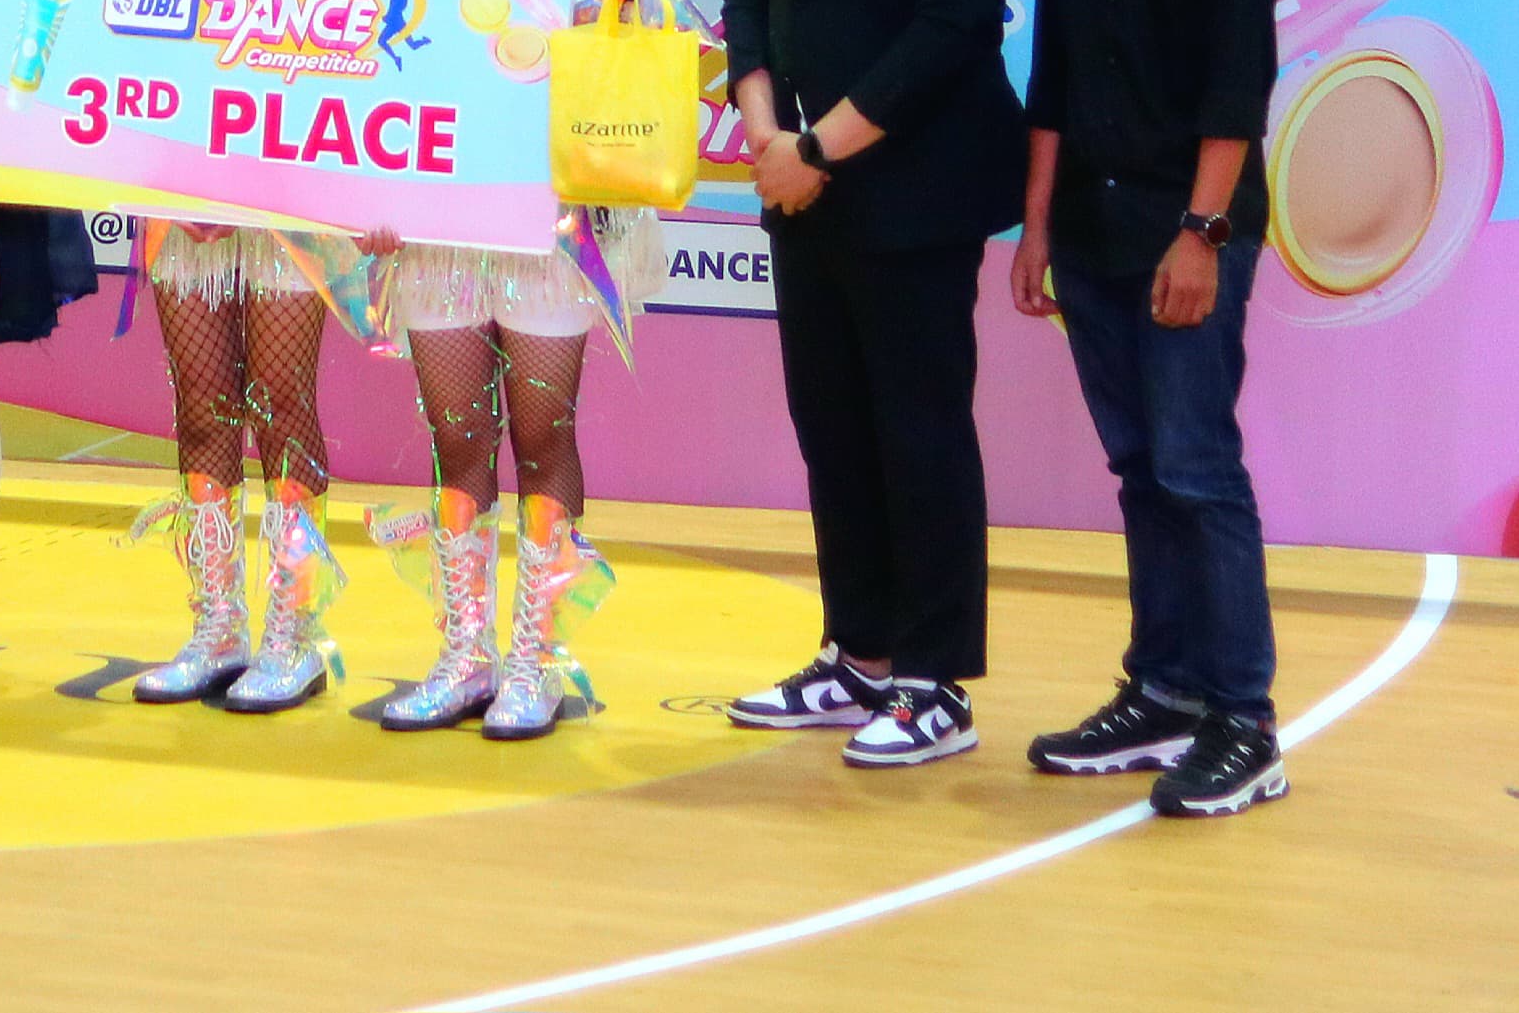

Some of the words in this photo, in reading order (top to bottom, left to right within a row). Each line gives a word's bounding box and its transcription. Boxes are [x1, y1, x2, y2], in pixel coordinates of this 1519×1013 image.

[244, 47, 378, 84] Competition
[63, 78, 181, 147] 3RD
[208, 87, 459, 174] PLACE
[665, 248, 770, 284] ANCE
